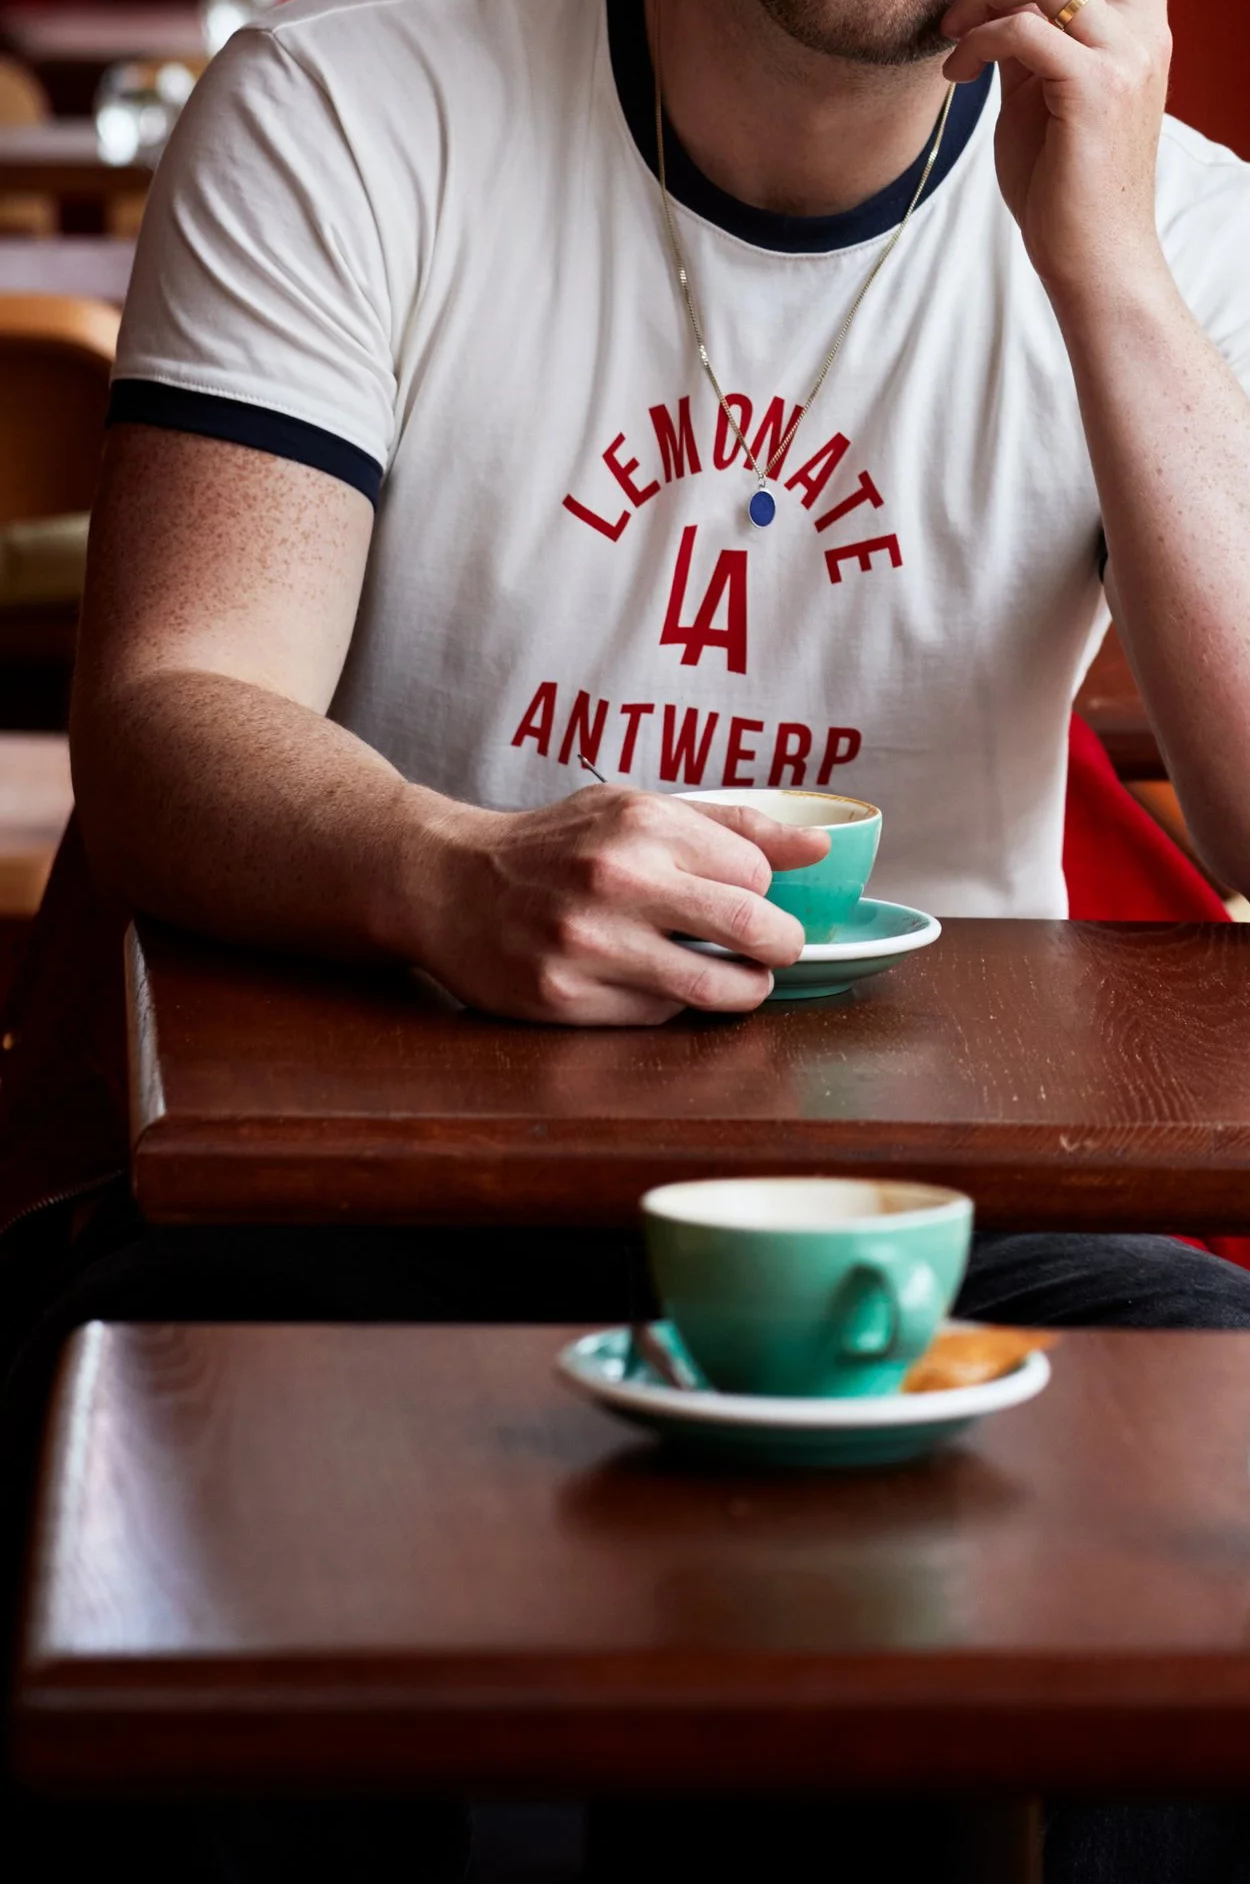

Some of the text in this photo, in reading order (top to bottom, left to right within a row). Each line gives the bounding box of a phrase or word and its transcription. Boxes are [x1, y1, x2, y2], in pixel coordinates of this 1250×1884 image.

[562, 393, 903, 584] LEMONATE
[659, 524, 748, 675] LA
[511, 681, 861, 788] ANTWERP
